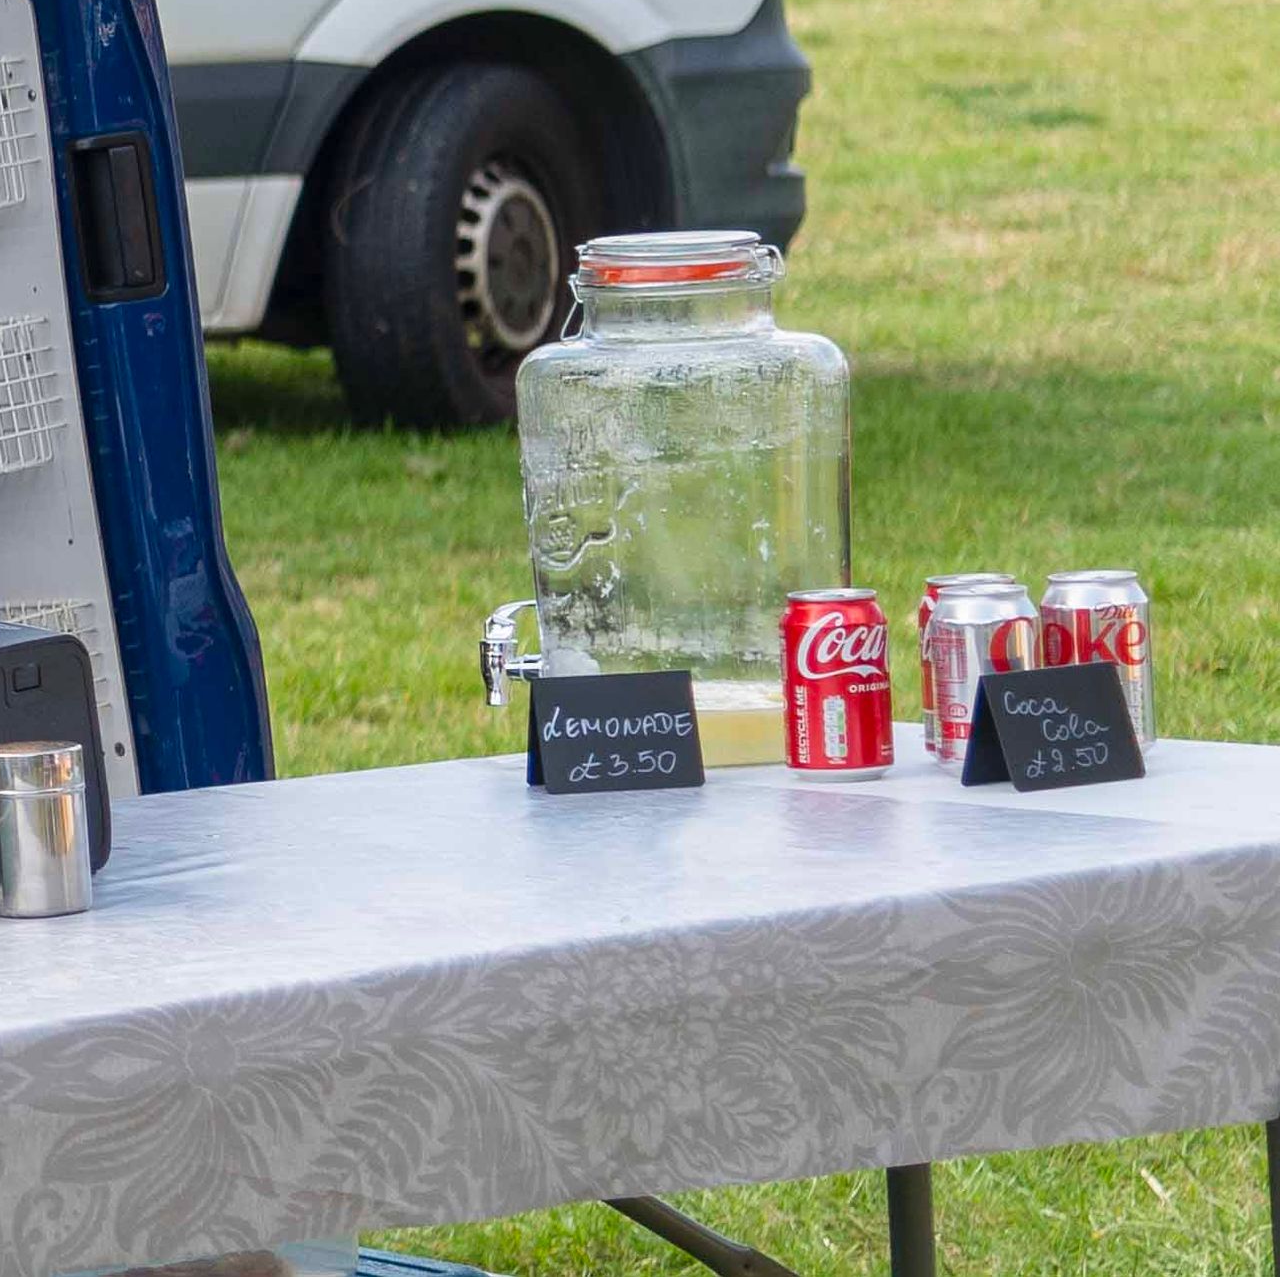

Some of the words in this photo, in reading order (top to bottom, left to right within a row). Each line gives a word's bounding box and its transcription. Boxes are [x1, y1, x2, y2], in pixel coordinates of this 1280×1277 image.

[1094, 603, 1137, 621] Diet
[797, 611, 886, 679] Coca
[795, 685, 805, 706] ME
[849, 681, 890, 694] ORIGIN
[1004, 691, 1068, 716] Coca
[797, 708, 807, 764] RECYCLE
[1042, 713, 1110, 741] Cola
[569, 750, 677, 782] £3.50
